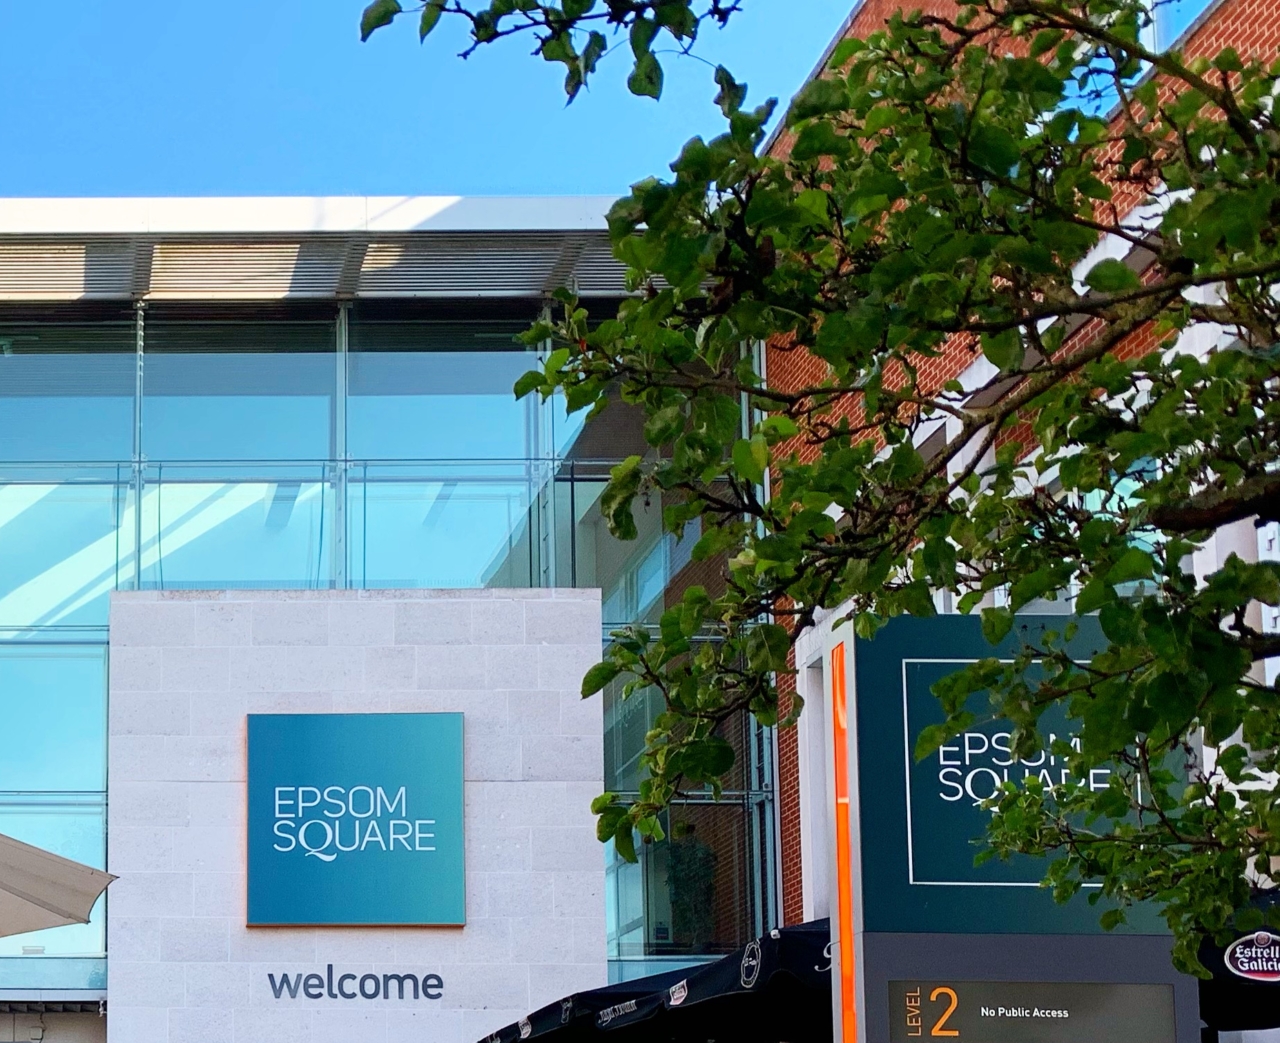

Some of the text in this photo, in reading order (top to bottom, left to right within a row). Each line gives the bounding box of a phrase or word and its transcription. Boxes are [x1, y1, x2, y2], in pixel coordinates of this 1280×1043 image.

[275, 786, 406, 818] EPSOM
[273, 819, 436, 862] SQUARE
[268, 964, 444, 999] welcome
[906, 987, 922, 1036] LEVEL
[929, 986, 959, 1036] 2
[981, 1007, 1069, 1018] No Public Access
